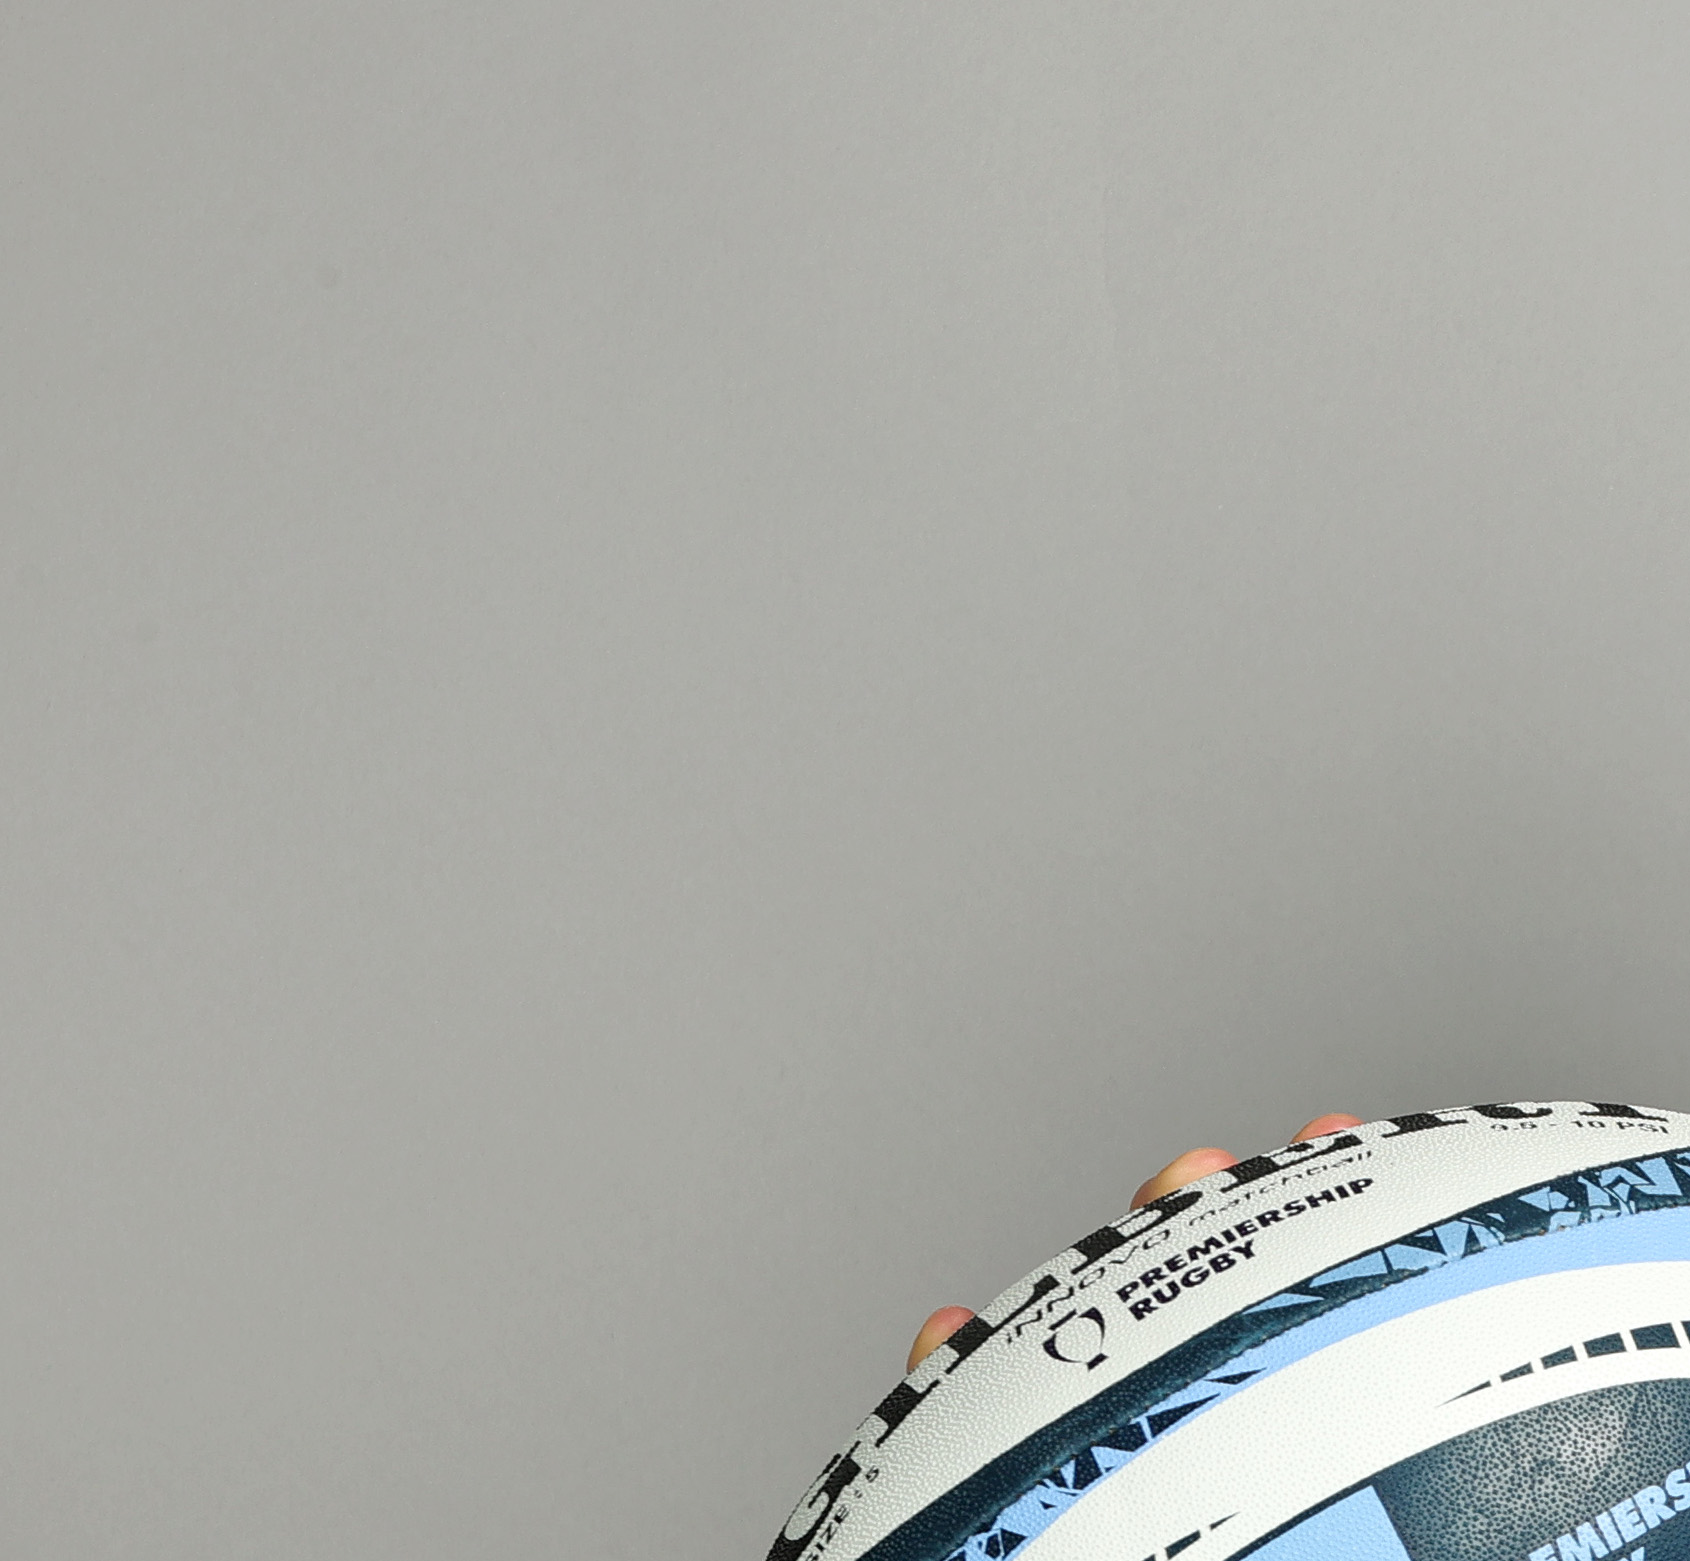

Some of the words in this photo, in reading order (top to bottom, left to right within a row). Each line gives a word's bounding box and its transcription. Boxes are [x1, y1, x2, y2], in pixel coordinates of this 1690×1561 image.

[1569, 1119, 1604, 1129] 10
[1617, 1120, 1670, 1135] PSI
[1115, 1177, 1374, 1303] PREMIERSHIP
[1128, 1239, 1259, 1321] RUGBY
